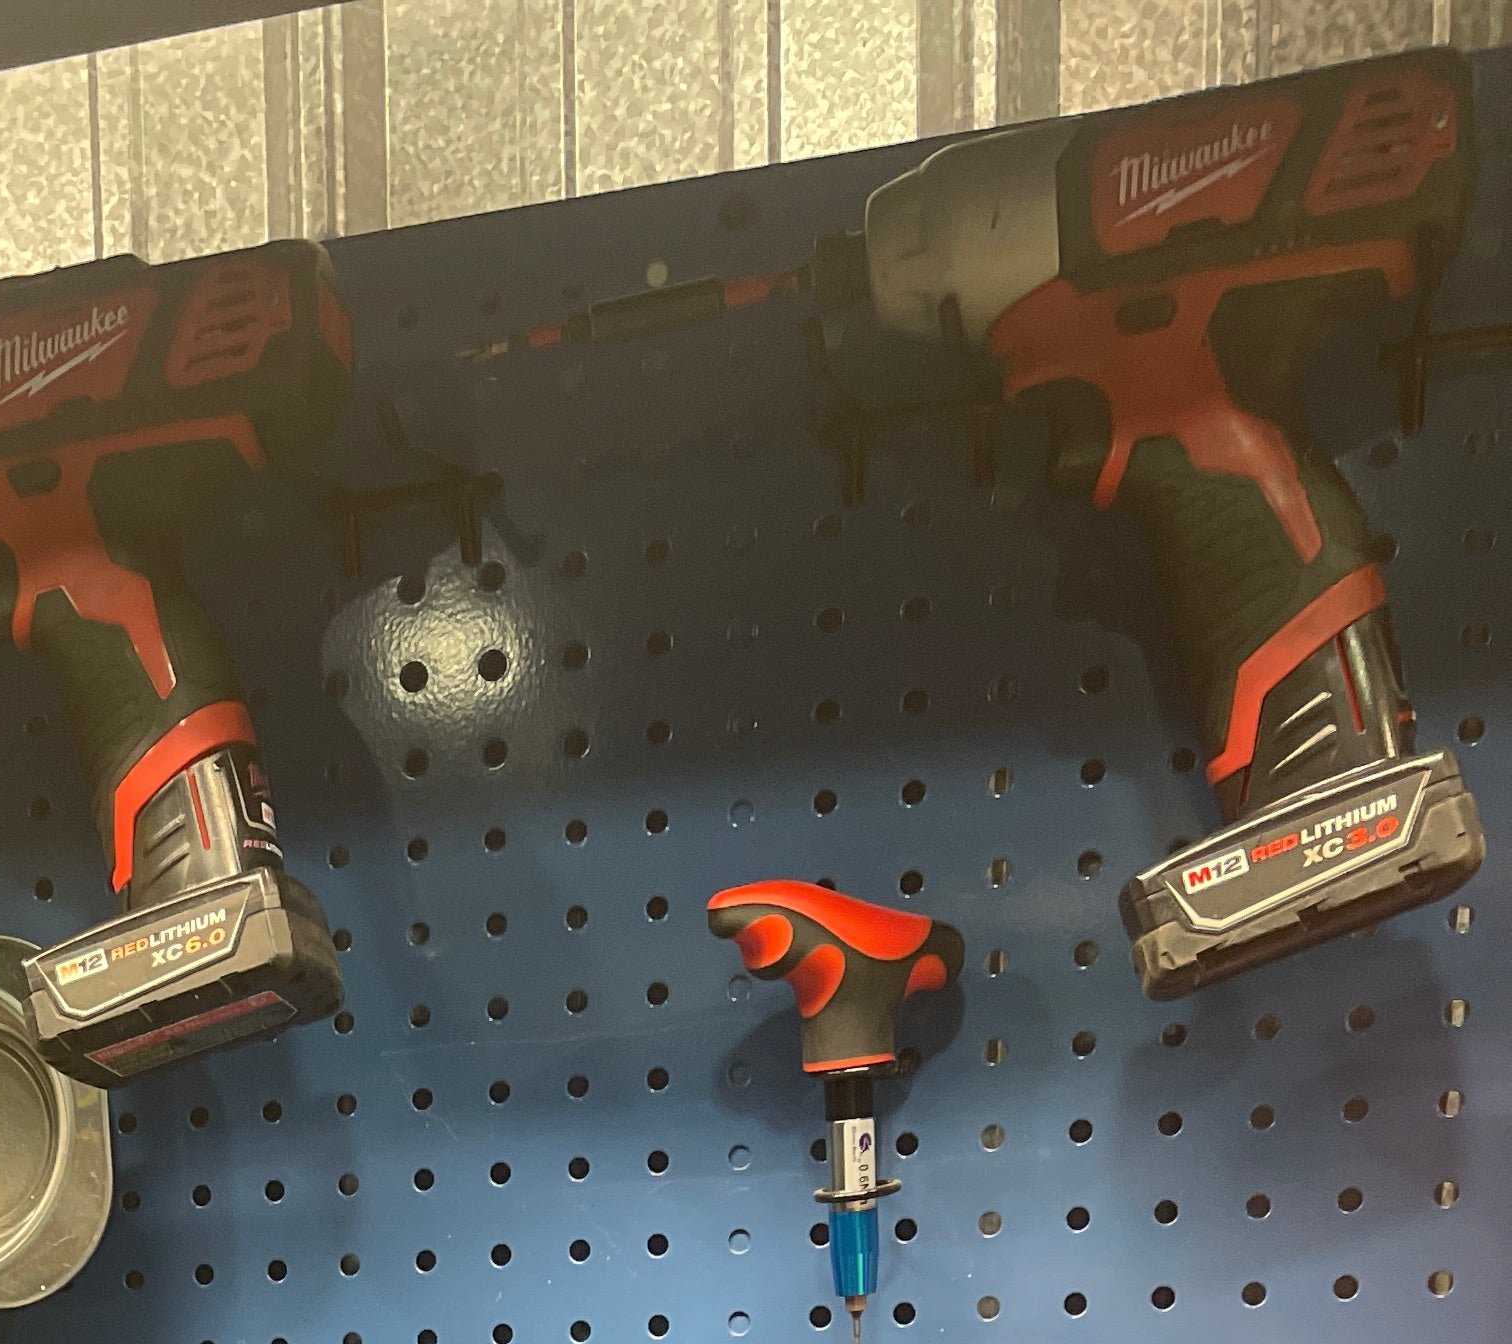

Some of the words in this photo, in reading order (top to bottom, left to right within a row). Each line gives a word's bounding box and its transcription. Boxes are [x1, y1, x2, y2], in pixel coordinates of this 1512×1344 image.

[1110, 120, 1272, 207] Milwaukee
[1188, 854, 1243, 888] M12
[59, 952, 104, 981] M12
